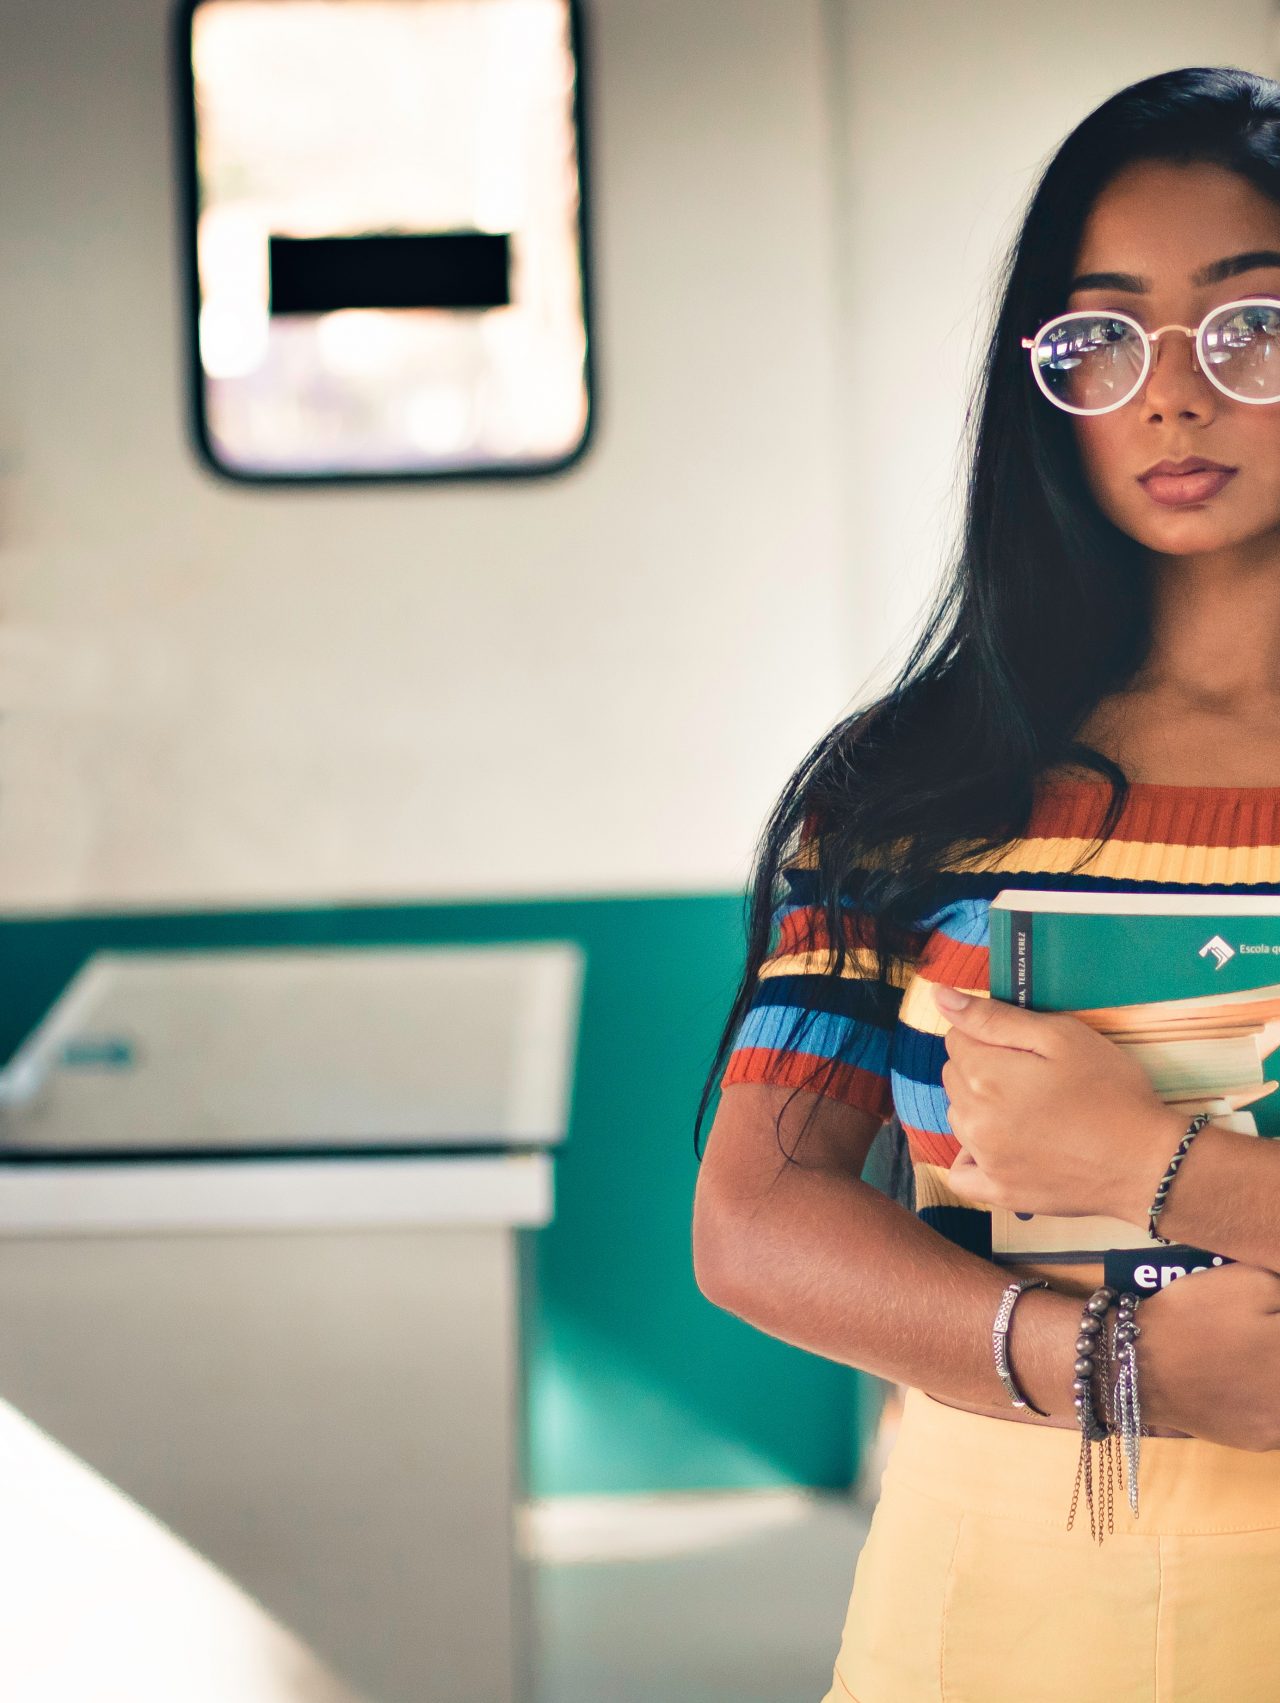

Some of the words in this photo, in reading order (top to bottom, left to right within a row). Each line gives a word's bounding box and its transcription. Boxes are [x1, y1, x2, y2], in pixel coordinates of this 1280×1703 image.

[1018, 931, 1026, 955] PEREZ
[1240, 944, 1269, 954] Escola
[1018, 957, 1026, 986] TEREZA
[1133, 1256, 1223, 1289] en
